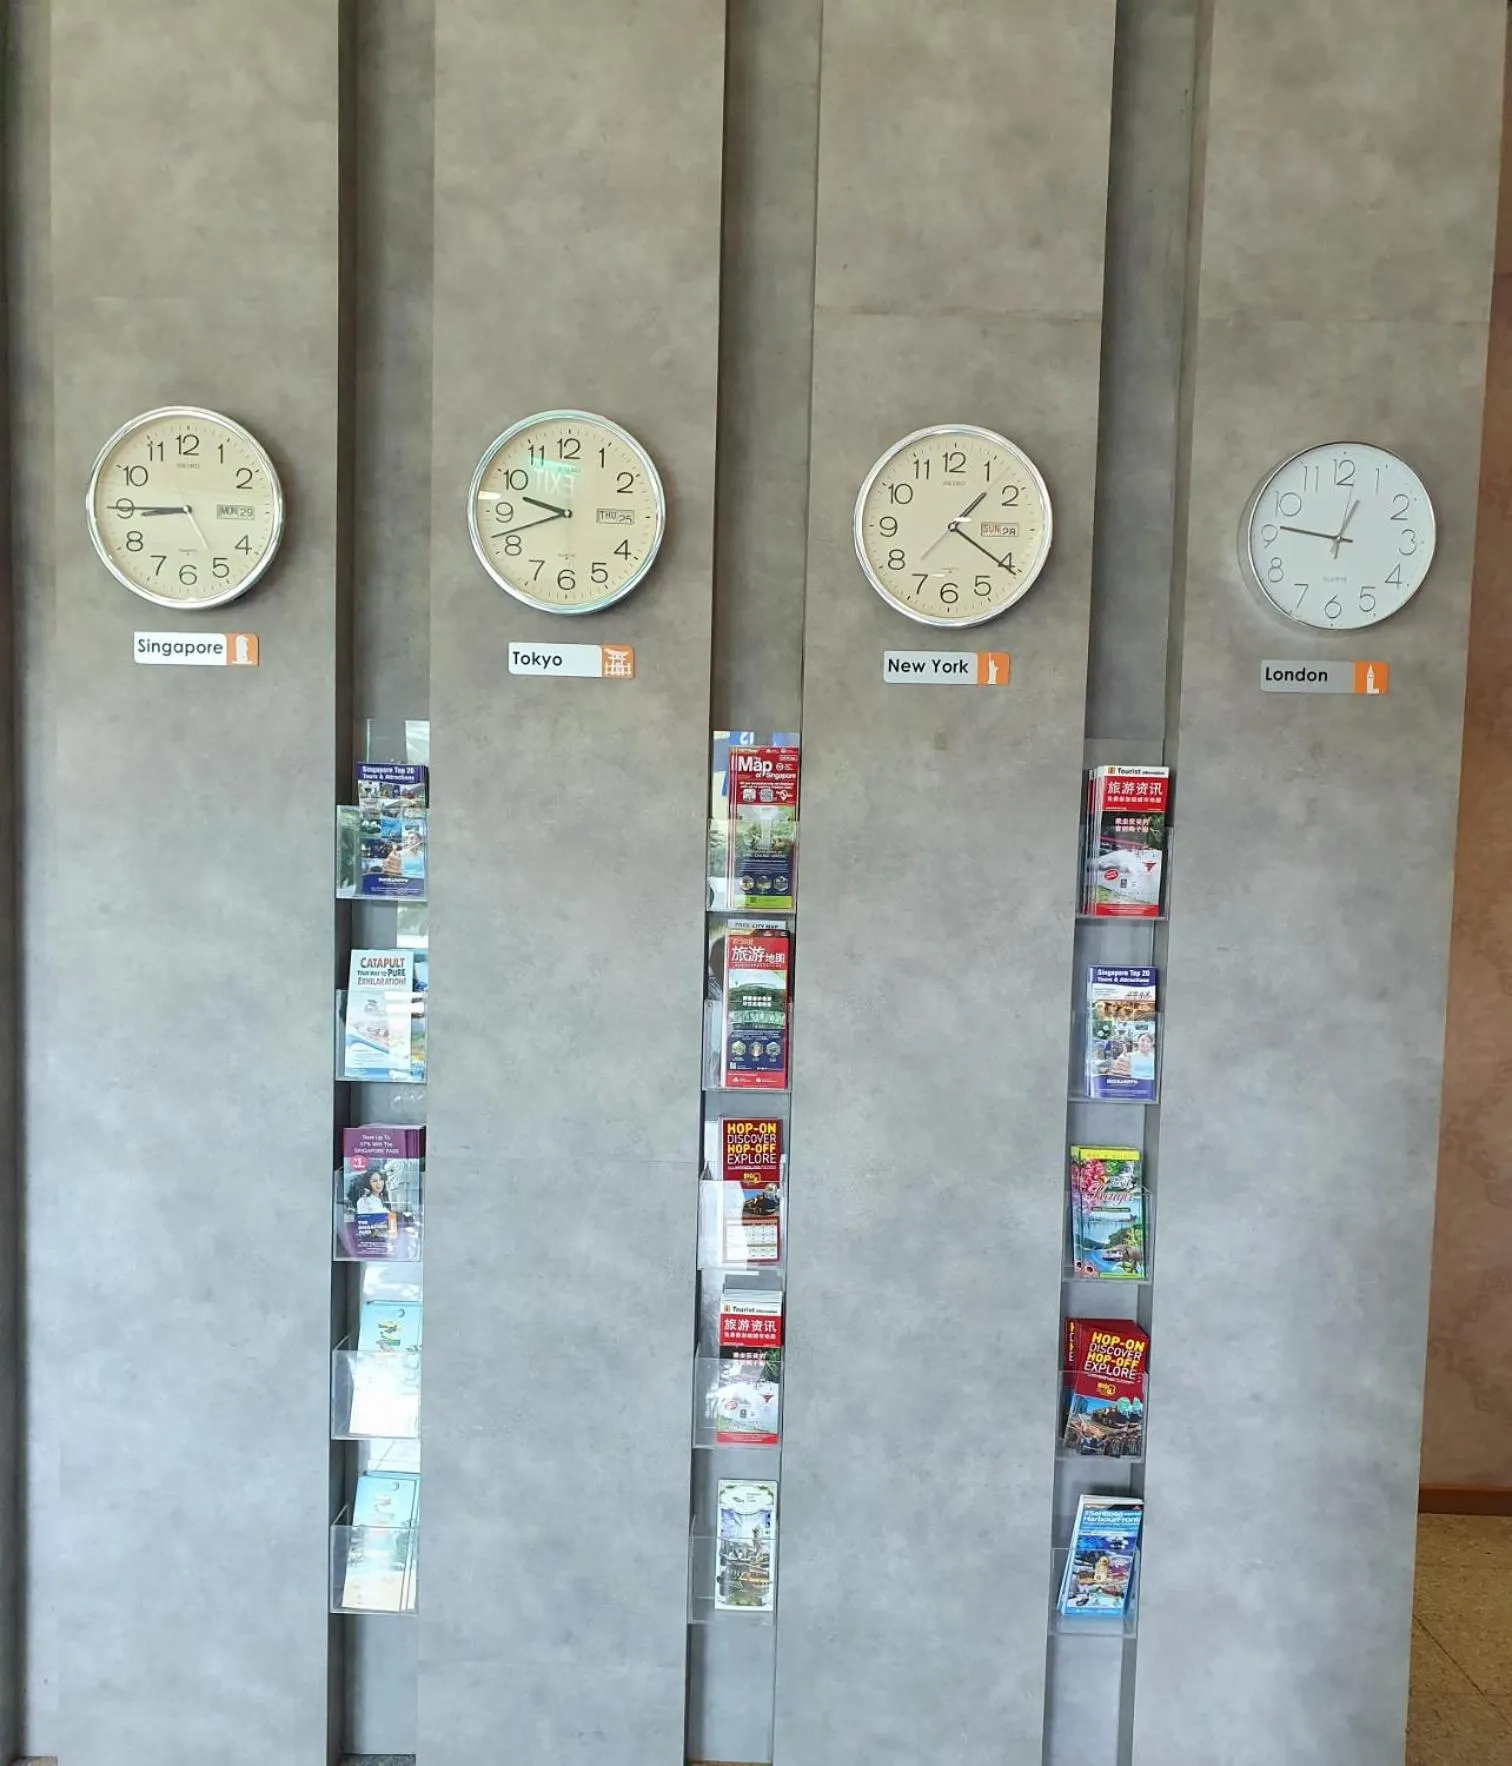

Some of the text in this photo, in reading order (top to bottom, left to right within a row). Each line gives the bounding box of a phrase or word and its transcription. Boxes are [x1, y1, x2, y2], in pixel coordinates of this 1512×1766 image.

[147, 441, 164, 461] 11
[175, 434, 200, 456] 12
[217, 444, 224, 464] 1
[528, 444, 545, 466] 11
[557, 438, 581, 460] 12
[598, 447, 605, 468] 1
[942, 452, 966, 473] 12
[123, 466, 148, 486] 10
[235, 468, 253, 489] 2
[503, 469, 528, 491] 10
[913, 459, 930, 480] 11
[984, 461, 991, 482] 1
[1303, 466, 1319, 492] 11
[1333, 459, 1356, 487] 12
[616, 472, 634, 494] 2
[1375, 467, 1381, 495] 1
[888, 483, 913, 505] 10
[1001, 485, 1019, 506] 2
[1275, 490, 1302, 517] 10
[116, 498, 134, 519] 9
[219, 507, 254, 517] MON 29
[495, 502, 514, 523] 9
[599, 510, 617, 520] THU
[1390, 493, 1409, 521] 2
[879, 516, 898, 537] 9
[983, 523, 1001, 533] SUN
[1261, 523, 1278, 549] 9
[125, 531, 144, 552] 8
[235, 535, 252, 555] 4
[504, 535, 522, 556] 8
[614, 539, 632, 560] 4
[1399, 529, 1417, 556] 3
[150, 555, 167, 576] 7
[211, 557, 230, 578] 5
[887, 549, 906, 570] 8
[998, 552, 1016, 573] 4
[1268, 557, 1284, 583] 8
[178, 565, 197, 585] 6
[528, 560, 545, 581] 7
[557, 569, 576, 590] 6
[590, 562, 609, 583] 5
[1385, 564, 1402, 589] 4
[912, 573, 928, 595] 7
[940, 583, 959, 603] 6
[973, 575, 992, 596] 5
[1293, 583, 1309, 609] 7
[1359, 586, 1376, 612] 5
[1324, 595, 1342, 619] 6
[138, 638, 224, 657] Singapore
[513, 652, 563, 669] Tokyo
[888, 659, 969, 674] New York
[1265, 667, 1328, 682] London
[738, 755, 773, 777] Map
[1117, 767, 1142, 775] Tourist
[1107, 781, 1163, 796] 旅游资讯
[731, 945, 785, 963] 旅游地图
[1097, 968, 1128, 977] Singapore
[1130, 969, 1141, 977] Top
[727, 1122, 777, 1134] HOP-ON
[727, 1134, 777, 1144] DISCOVER
[727, 1143, 777, 1154] HOP-OFF
[727, 1153, 777, 1164] EXPLORE
[724, 1319, 777, 1332] 旅游资讯
[1089, 1342, 1142, 1360] DISCOVER
[1092, 1332, 1145, 1352] HOP-ON
[1084, 1360, 1137, 1380] EXPLORE
[1087, 1352, 1140, 1368] HOP-OFF
